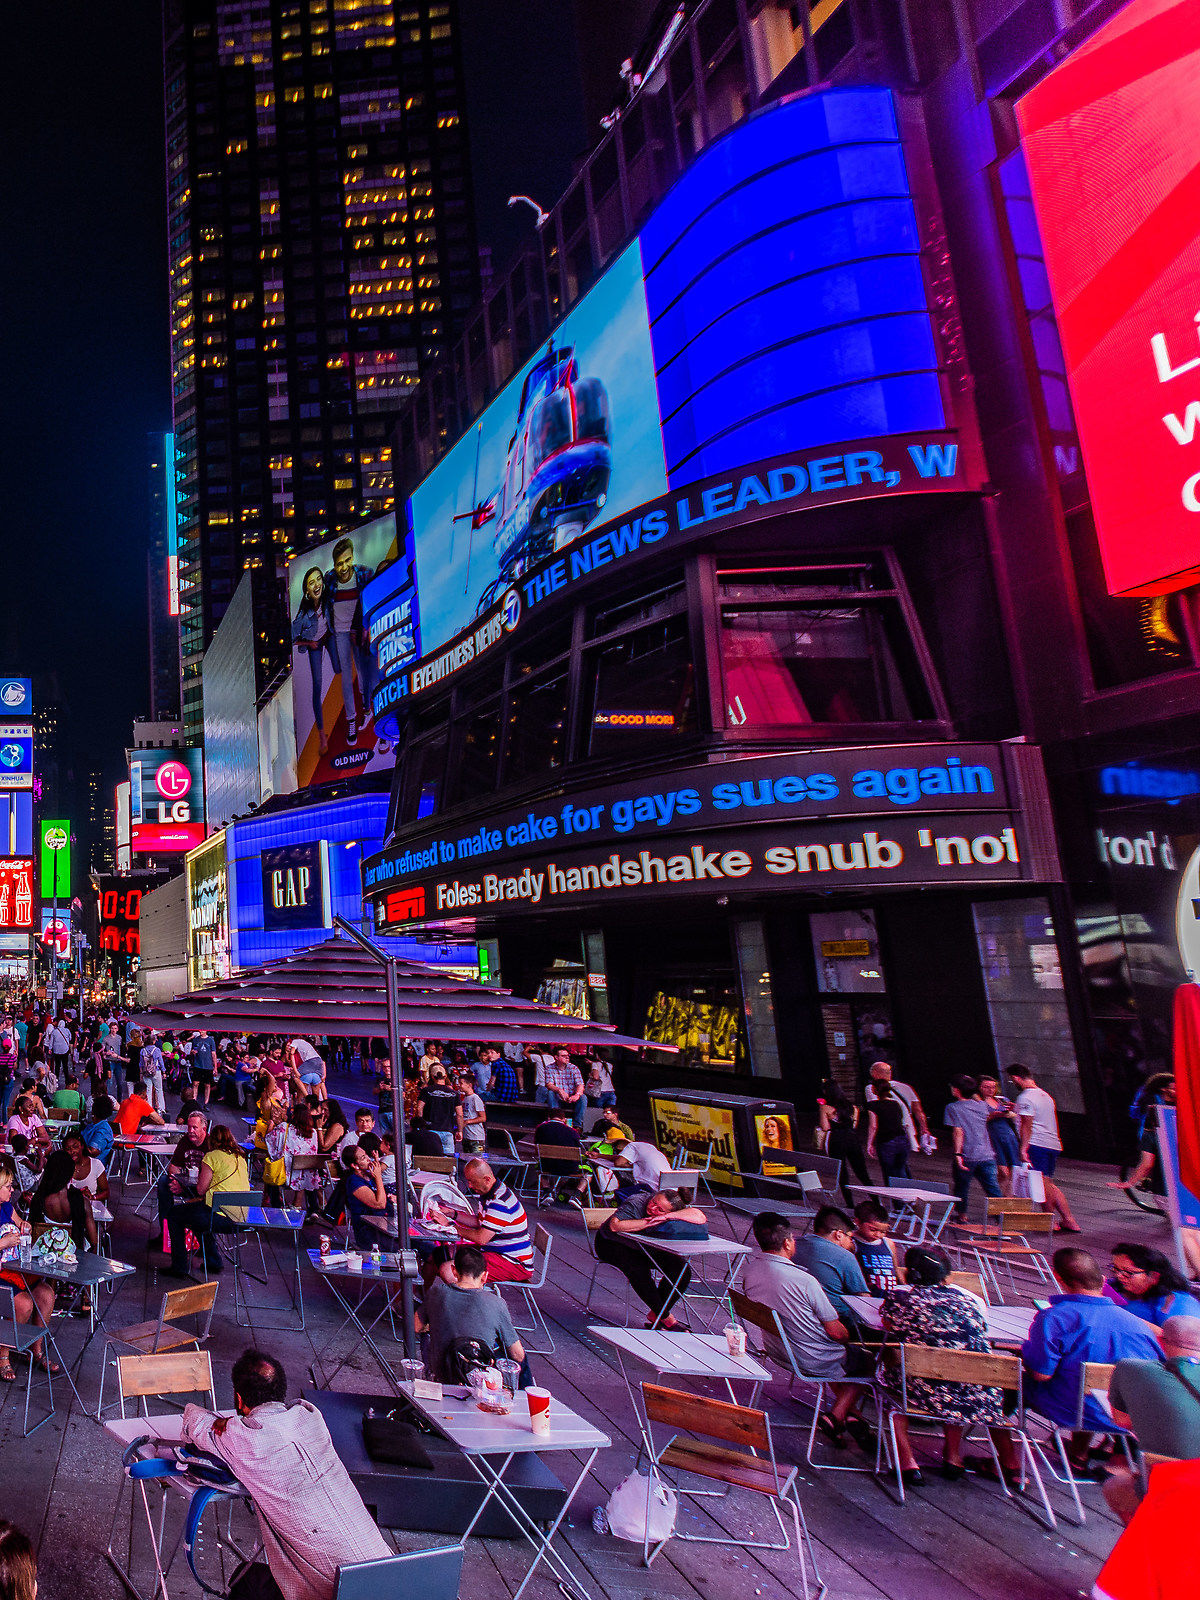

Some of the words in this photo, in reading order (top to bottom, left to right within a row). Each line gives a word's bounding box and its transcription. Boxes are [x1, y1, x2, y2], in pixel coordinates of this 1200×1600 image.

[523, 558, 567, 608] THE
[569, 509, 669, 581] NEWS
[677, 450, 900, 531] LEADER,
[412, 636, 475, 694] EYEWITNESS
[475, 612, 502, 657] NEWS
[610, 714, 644, 725] GOOD
[334, 756, 349, 766] OLD
[350, 751, 369, 765] NAVY
[159, 801, 191, 824] LG
[376, 859, 394, 882] who
[395, 841, 438, 876] refused
[439, 839, 456, 863] to
[457, 827, 503, 859] make
[506, 813, 558, 847] cake
[560, 804, 605, 835] for
[611, 787, 702, 833] gays
[712, 771, 840, 811] sues
[852, 757, 995, 805] again
[272, 866, 310, 908] GAP
[436, 880, 482, 910] Foles:
[483, 867, 545, 903] Brady
[547, 845, 753, 894] handshake
[765, 831, 903, 875] snub
